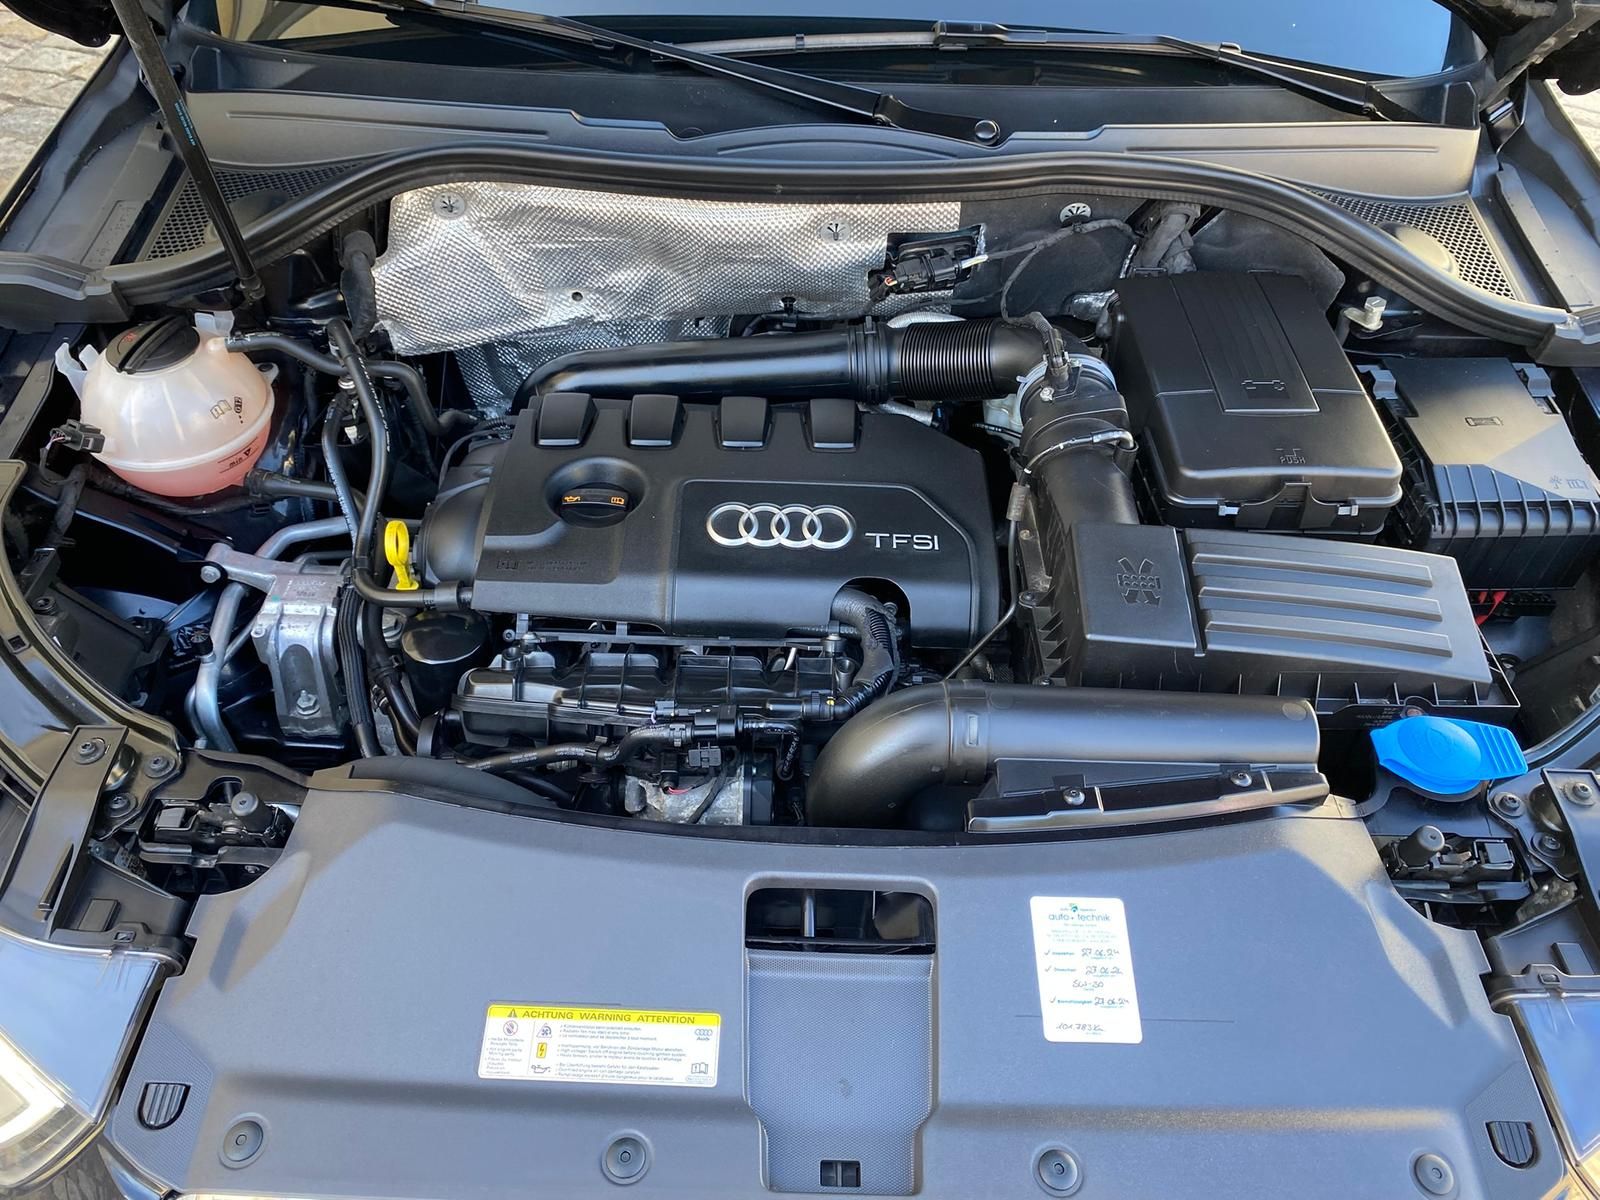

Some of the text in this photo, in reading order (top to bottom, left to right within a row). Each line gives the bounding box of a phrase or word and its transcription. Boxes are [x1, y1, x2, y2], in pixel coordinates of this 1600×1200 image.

[864, 532, 940, 550] TFSI
[1077, 913, 1111, 922] technik
[522, 1011, 695, 1024] ACHTUNG WARNING ATTENTION
